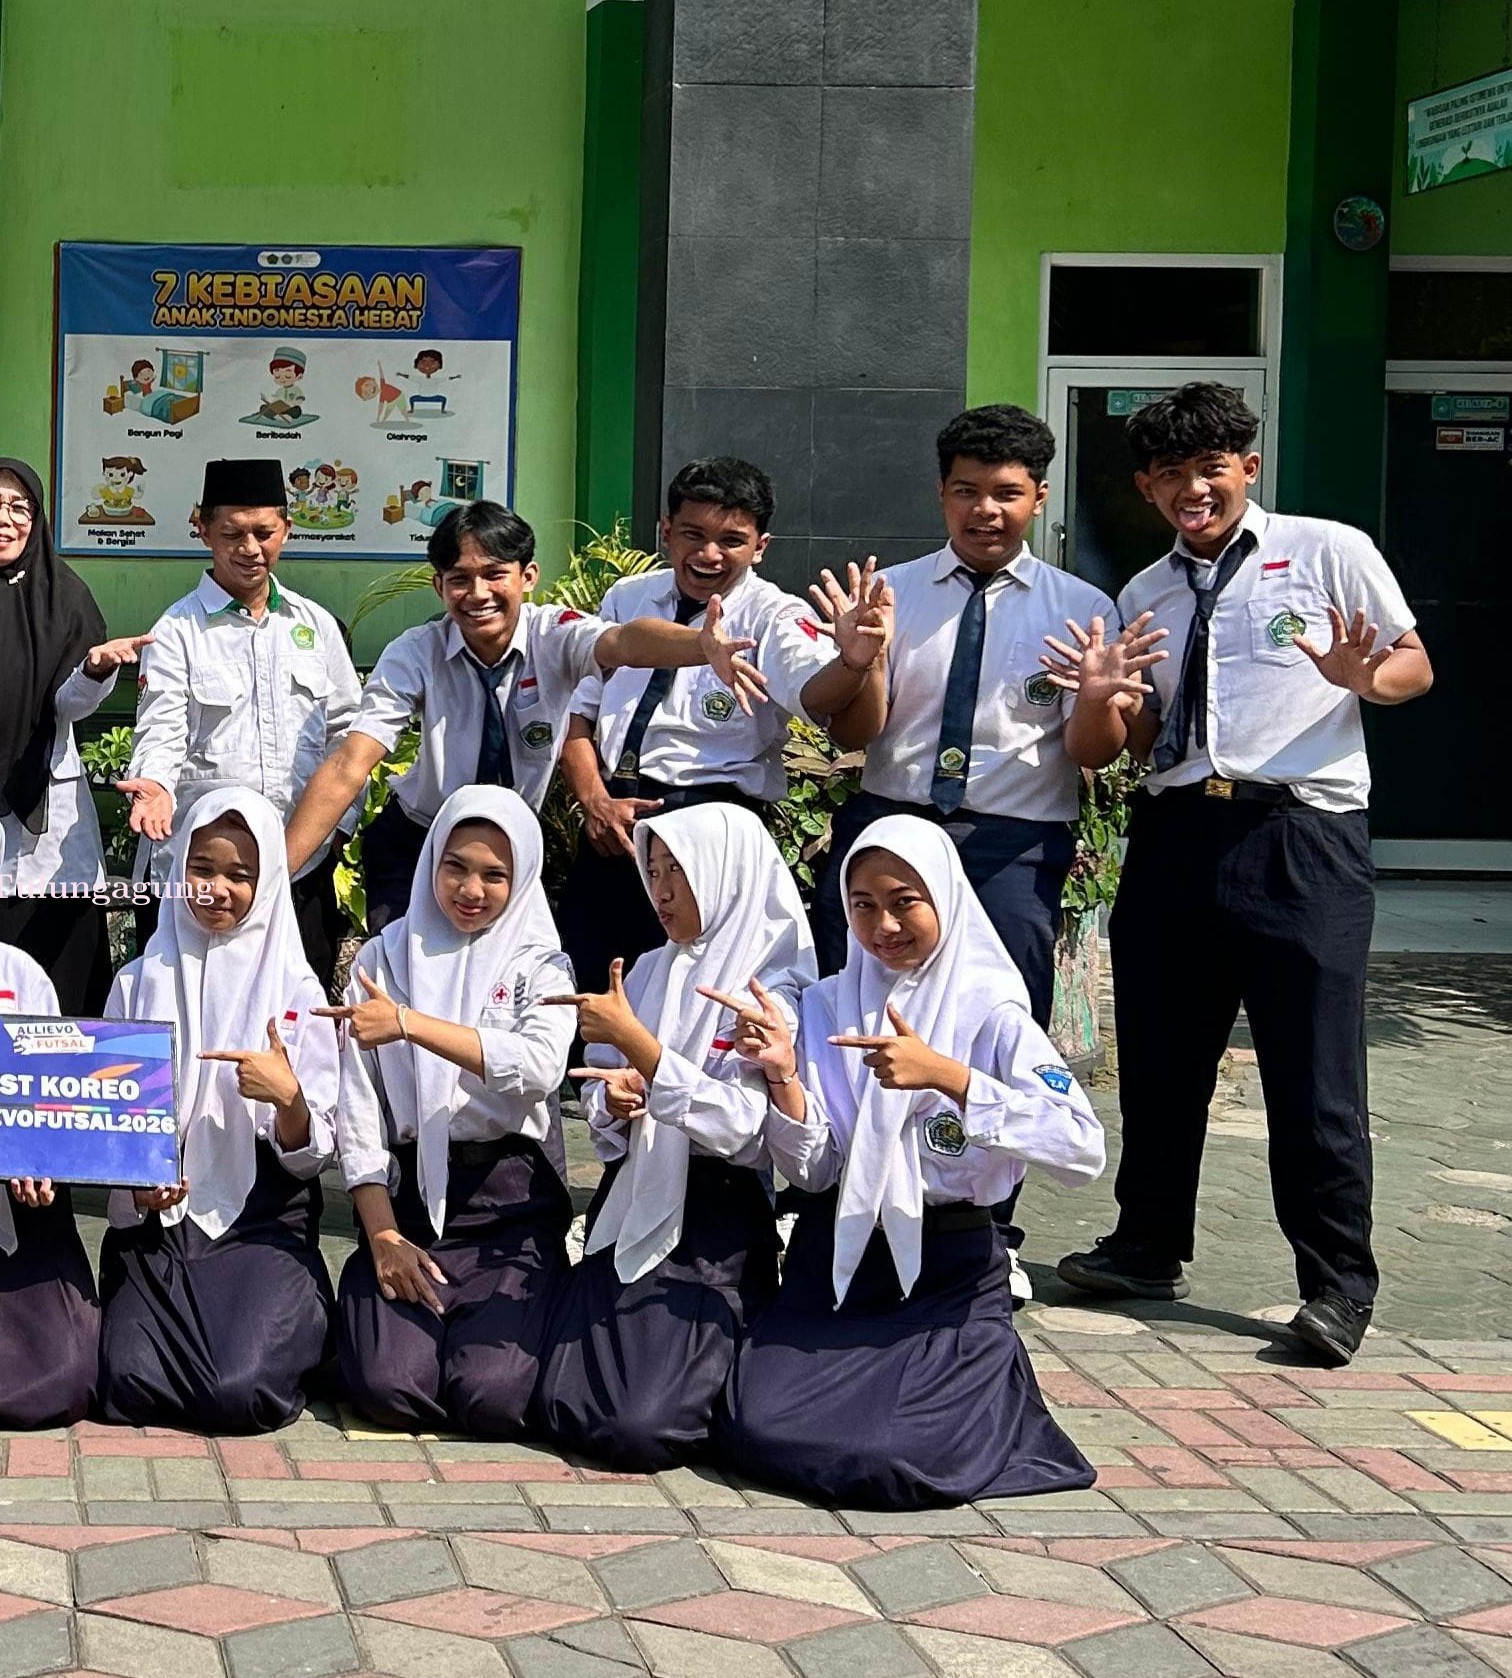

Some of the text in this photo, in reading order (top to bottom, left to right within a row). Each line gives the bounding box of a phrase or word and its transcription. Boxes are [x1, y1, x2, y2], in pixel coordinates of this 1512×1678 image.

[154, 272, 425, 308] 7 KEBIASAAN
[155, 306, 423, 331] ANAK INDONESIA HEBAT
[127, 429, 183, 439] Bangun Pagi
[255, 431, 302, 440] Beribadah
[386, 433, 428, 442] Olahraga
[88, 529, 145, 540] Makan Sehat
[17, 1024, 74, 1036] ALLIEVO
[36, 1039, 87, 1049] FUTSAL
[40, 1075, 141, 1102] KOREO
